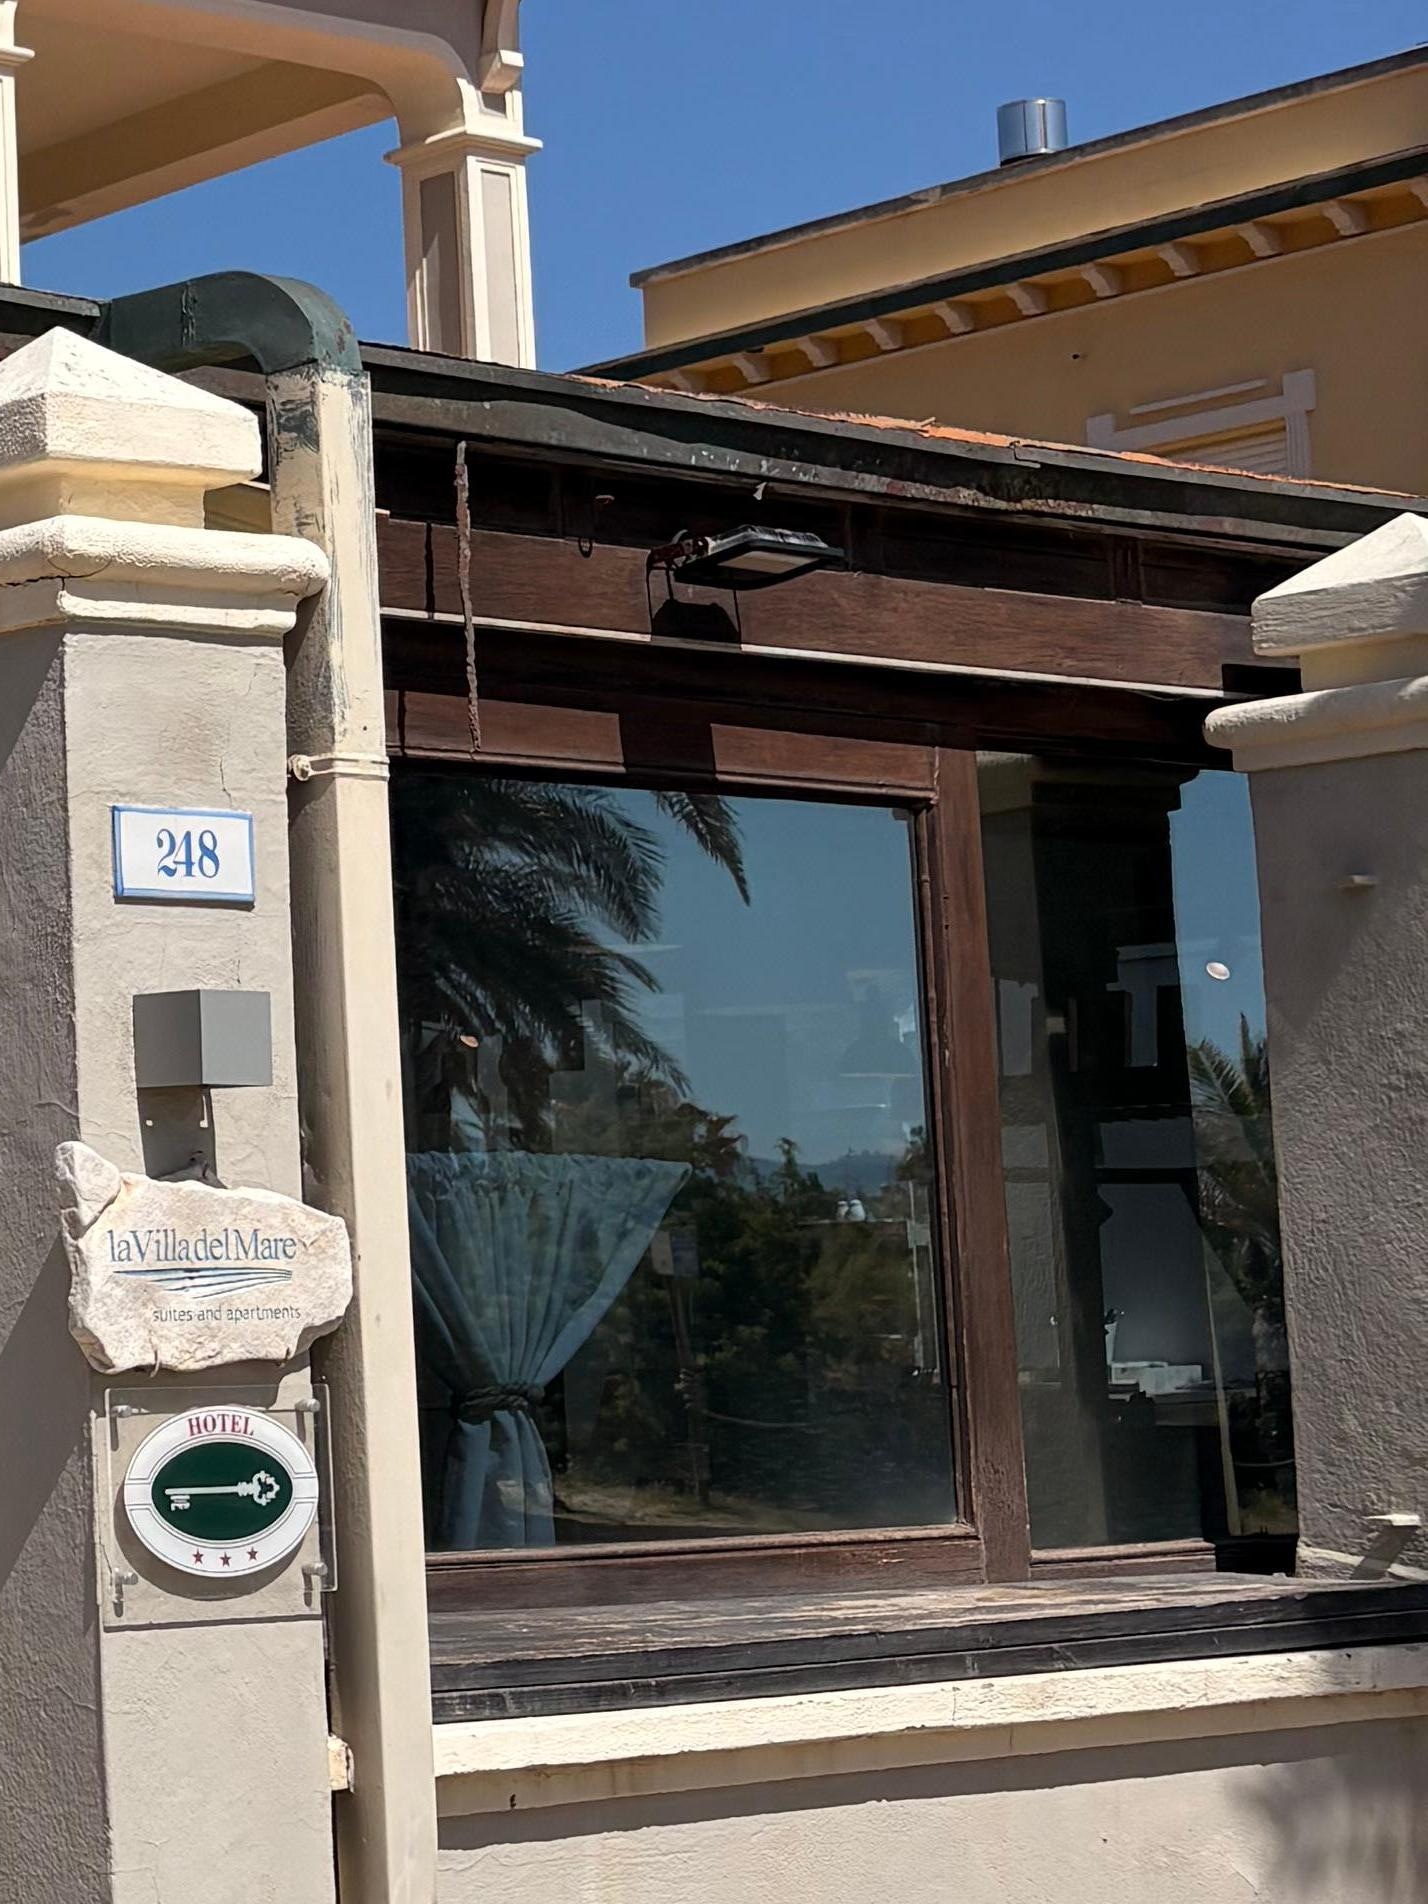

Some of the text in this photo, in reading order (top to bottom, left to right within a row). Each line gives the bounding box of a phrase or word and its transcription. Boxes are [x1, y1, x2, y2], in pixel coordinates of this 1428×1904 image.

[156, 828, 220, 879] 248
[233, 1227, 297, 1262] Mare
[152, 1304, 302, 1325] suites and apartments
[187, 1413, 255, 1438] HOTEL
